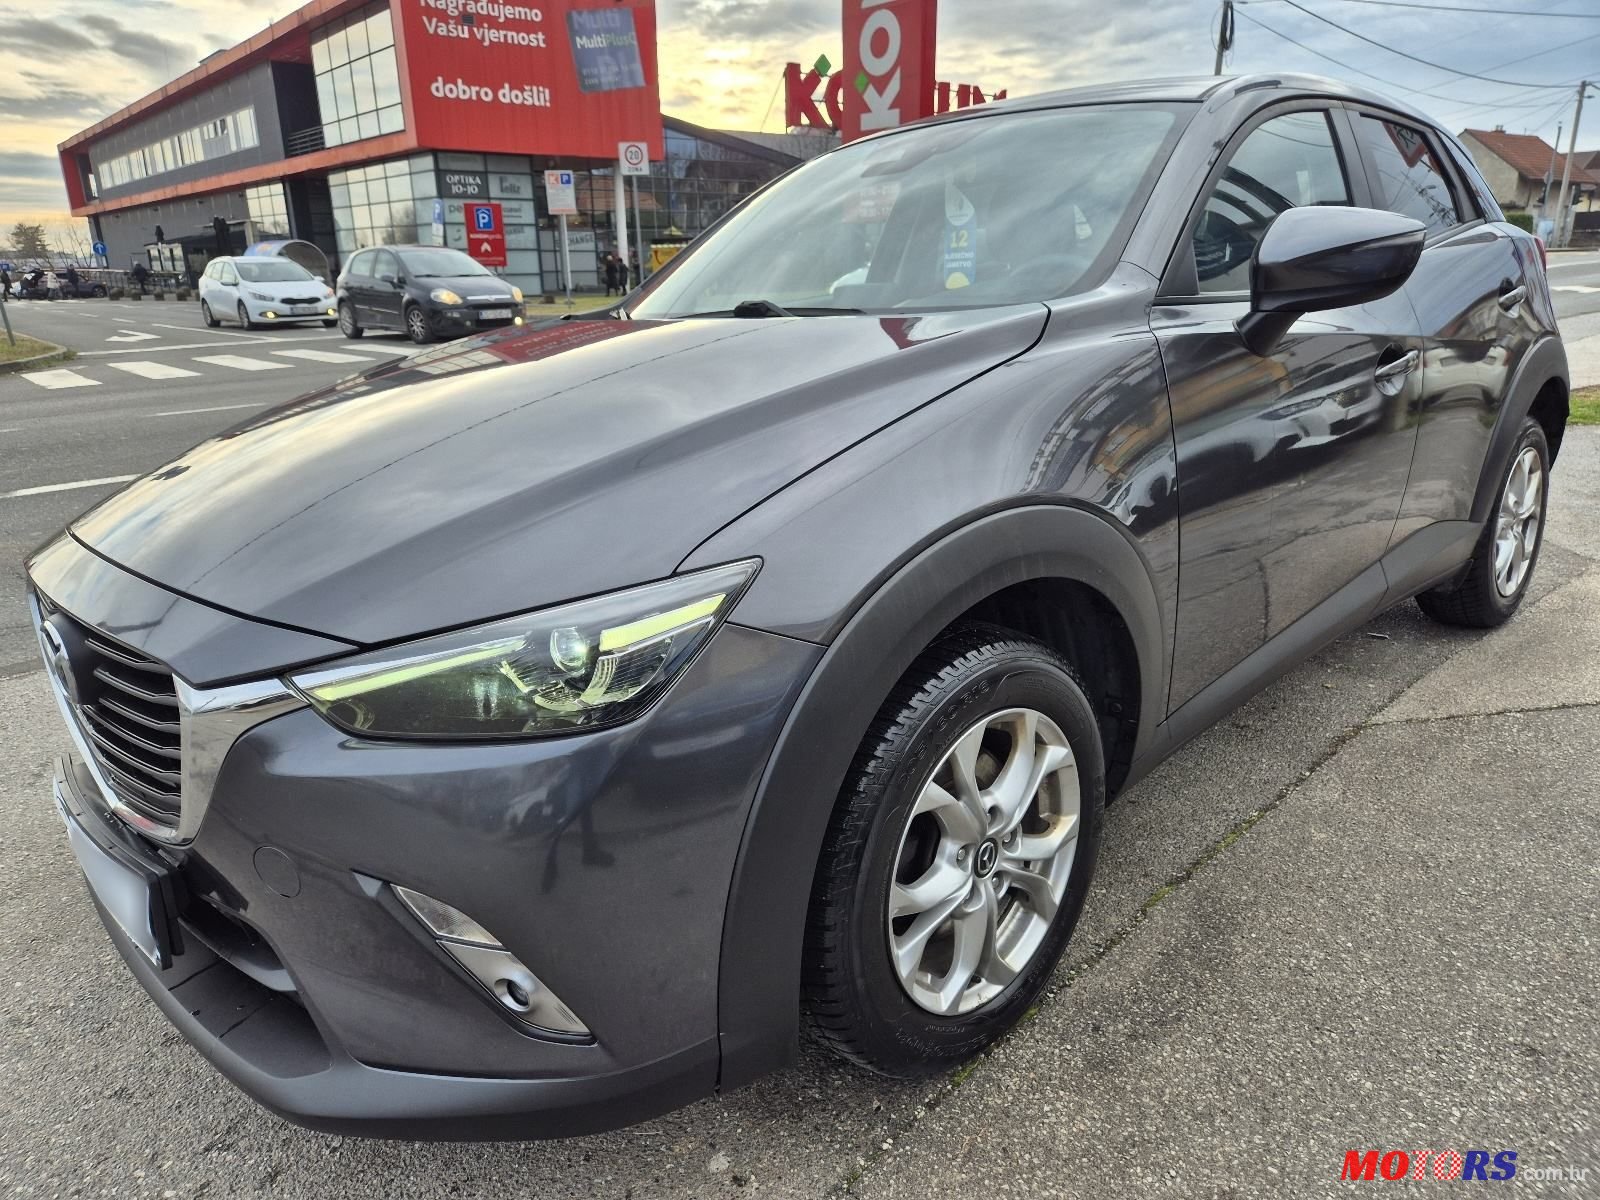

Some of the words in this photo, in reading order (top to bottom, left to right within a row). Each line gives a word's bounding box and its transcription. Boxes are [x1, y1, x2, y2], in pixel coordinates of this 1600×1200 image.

[421, 16, 470, 39] Vašu
[473, 23, 548, 48] vjernost
[430, 76, 494, 102] dobro
[497, 82, 551, 107] došli!
[629, 150, 640, 161] 20
[446, 174, 481, 185] OPTIKA
[950, 229, 969, 249] 12
